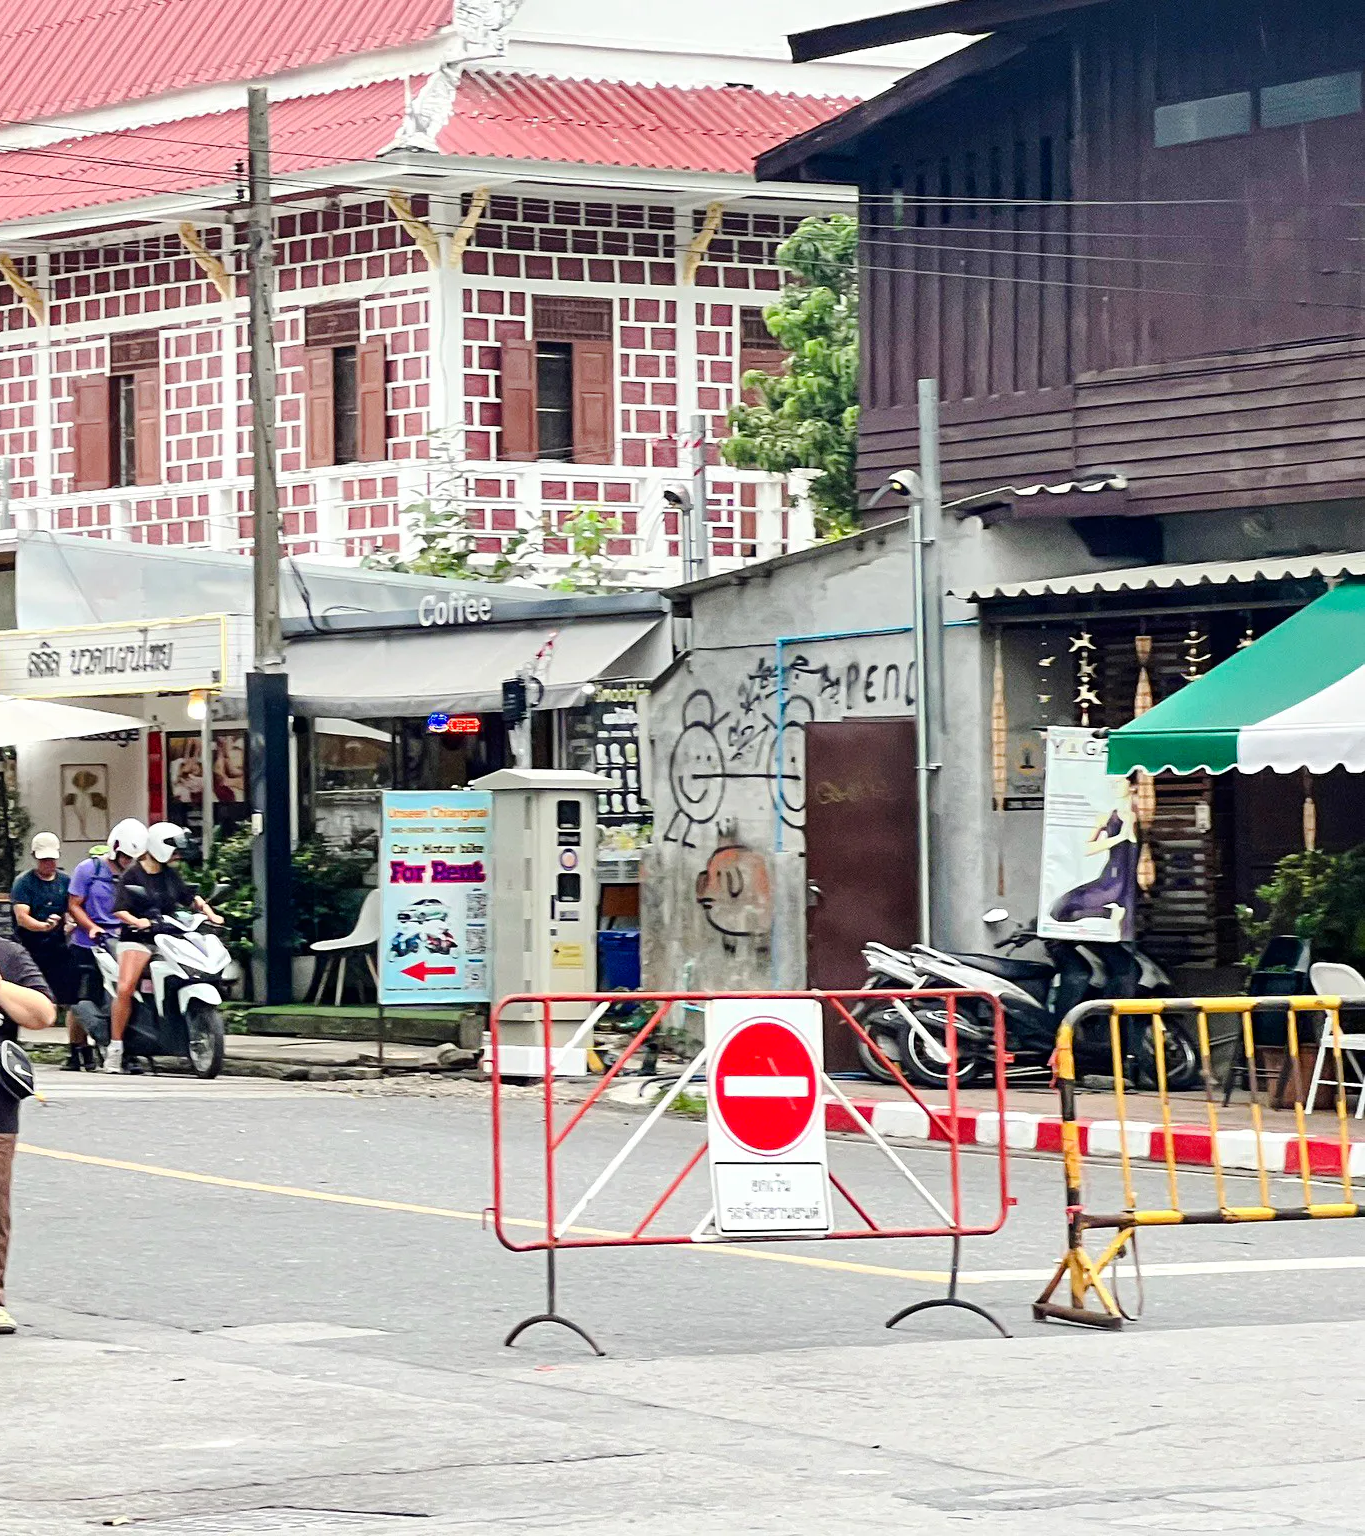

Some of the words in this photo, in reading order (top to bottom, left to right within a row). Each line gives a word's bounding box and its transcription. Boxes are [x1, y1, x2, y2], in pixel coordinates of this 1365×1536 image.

[418, 591, 492, 627] Coffee
[392, 844, 409, 853] Car
[390, 861, 426, 883] For
[431, 861, 486, 883] Rent
